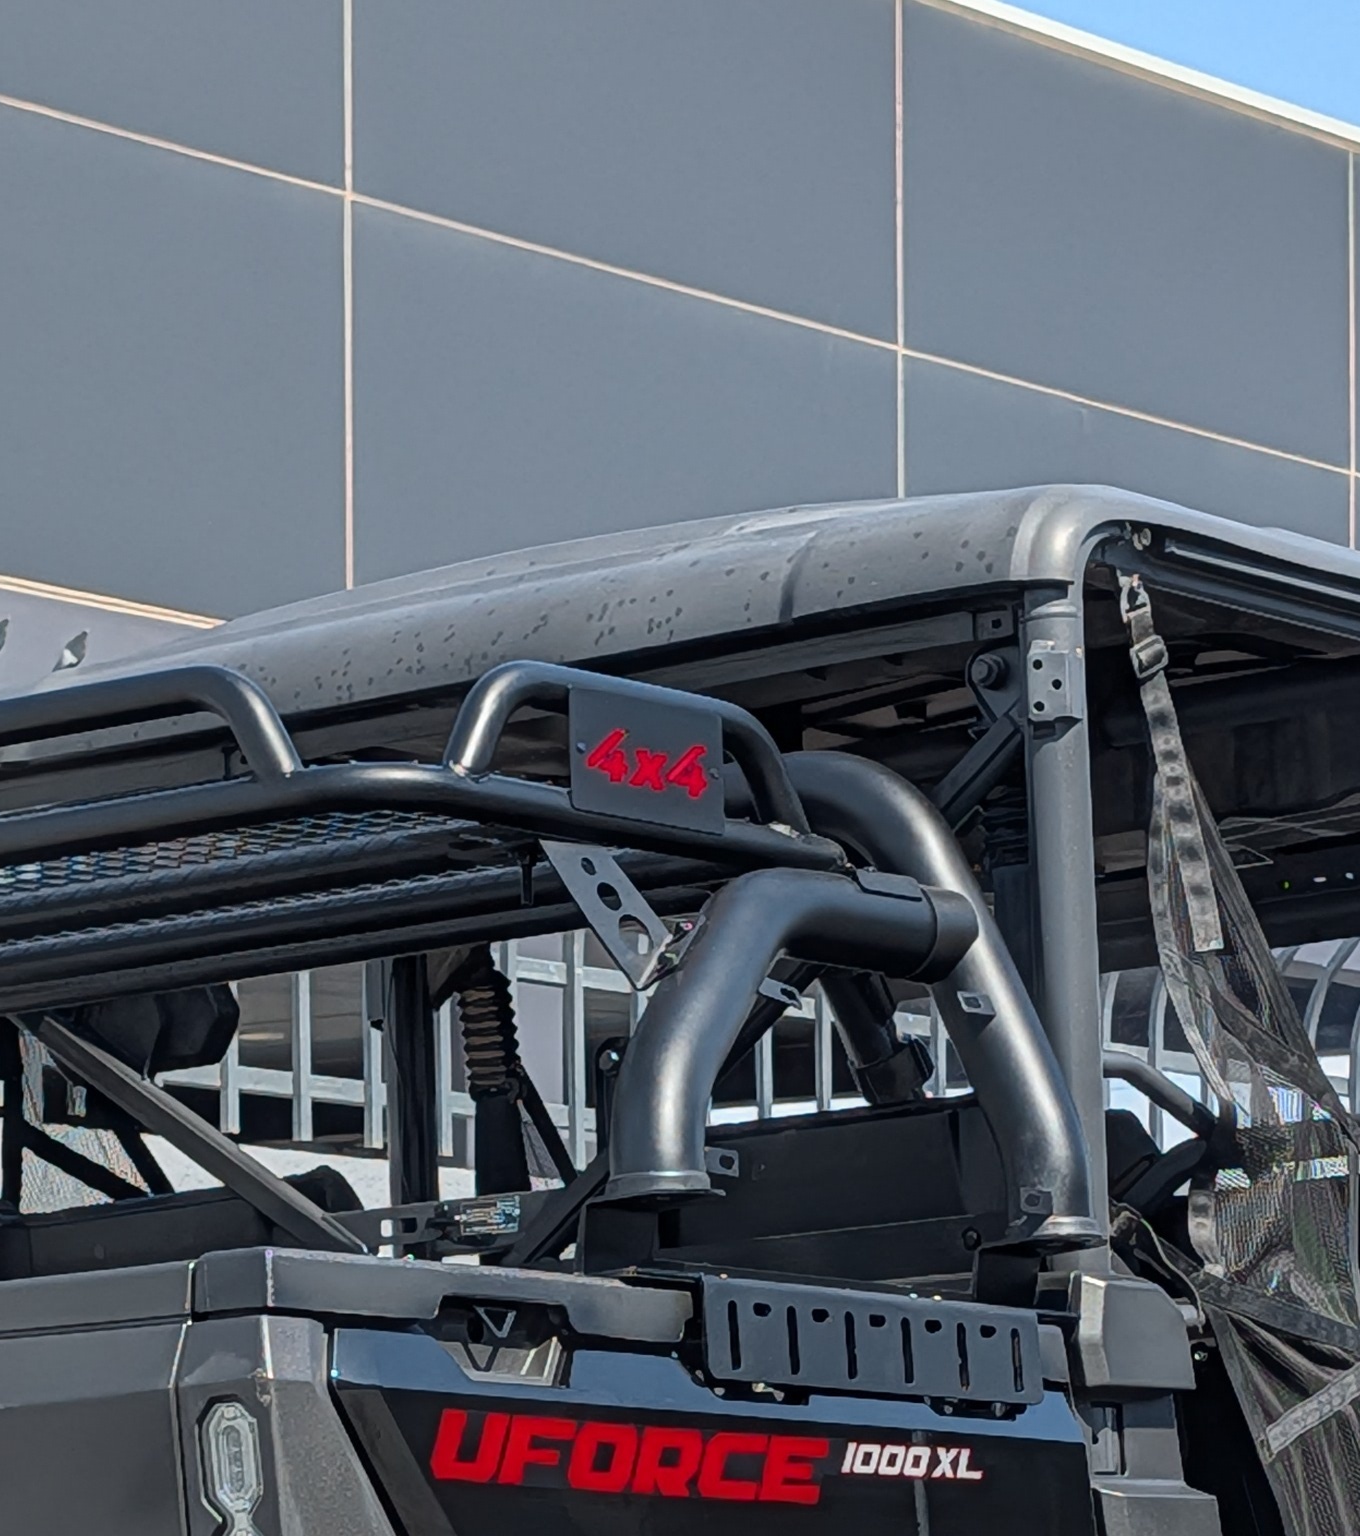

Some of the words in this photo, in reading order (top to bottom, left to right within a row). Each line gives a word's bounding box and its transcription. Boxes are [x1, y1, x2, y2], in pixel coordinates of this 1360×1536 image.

[587, 728, 708, 799] 4x4
[429, 1407, 831, 1506] UFORCE
[841, 1441, 932, 1478] 1000
[930, 1447, 984, 1481] XL
